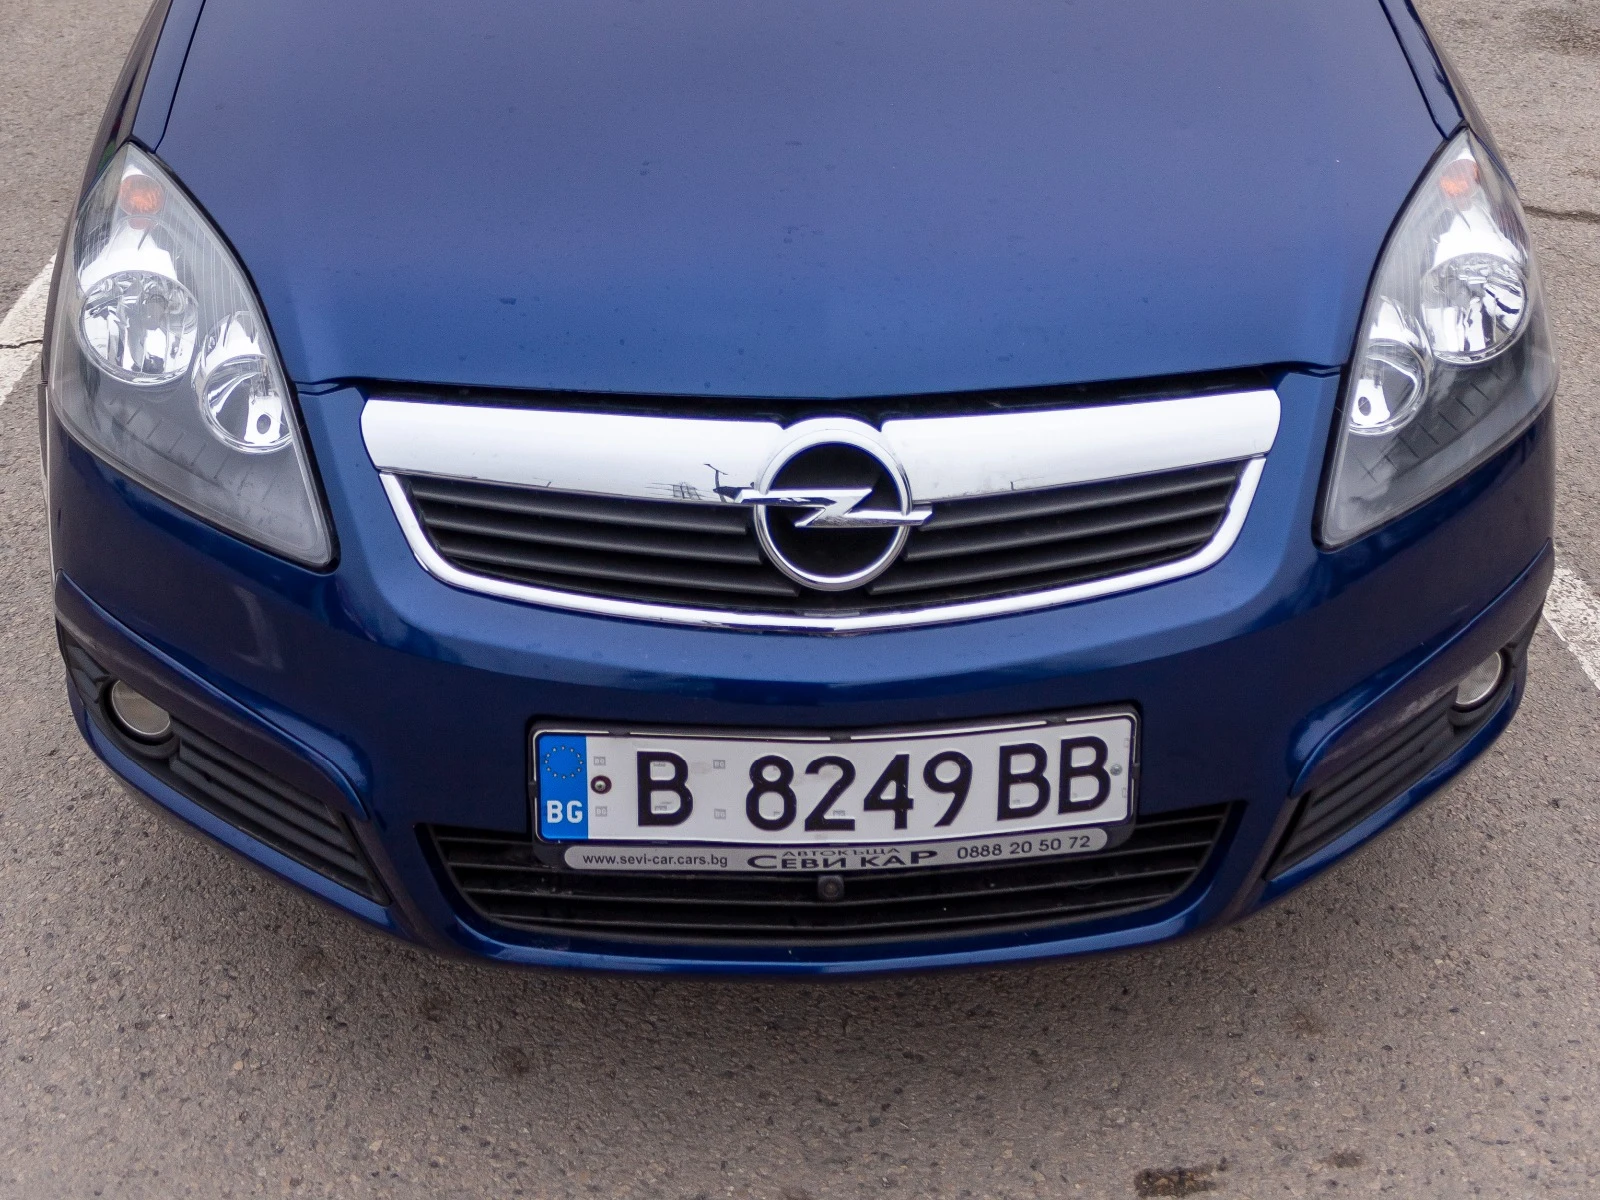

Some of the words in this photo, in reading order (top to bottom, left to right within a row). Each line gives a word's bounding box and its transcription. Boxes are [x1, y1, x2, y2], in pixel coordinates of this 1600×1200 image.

[746, 750, 973, 832] 8249
[546, 799, 583, 823] BG
[782, 848, 900, 857] АВТОКЪЩА
[957, 844, 1003, 859] 0888
[1009, 841, 1033, 855] 20
[1038, 838, 1062, 852] 50
[1069, 835, 1091, 849] 72
[583, 852, 728, 867] www.sevi-car.cars.bg
[747, 855, 847, 869] СЕВИ
[860, 850, 938, 867] КАР
